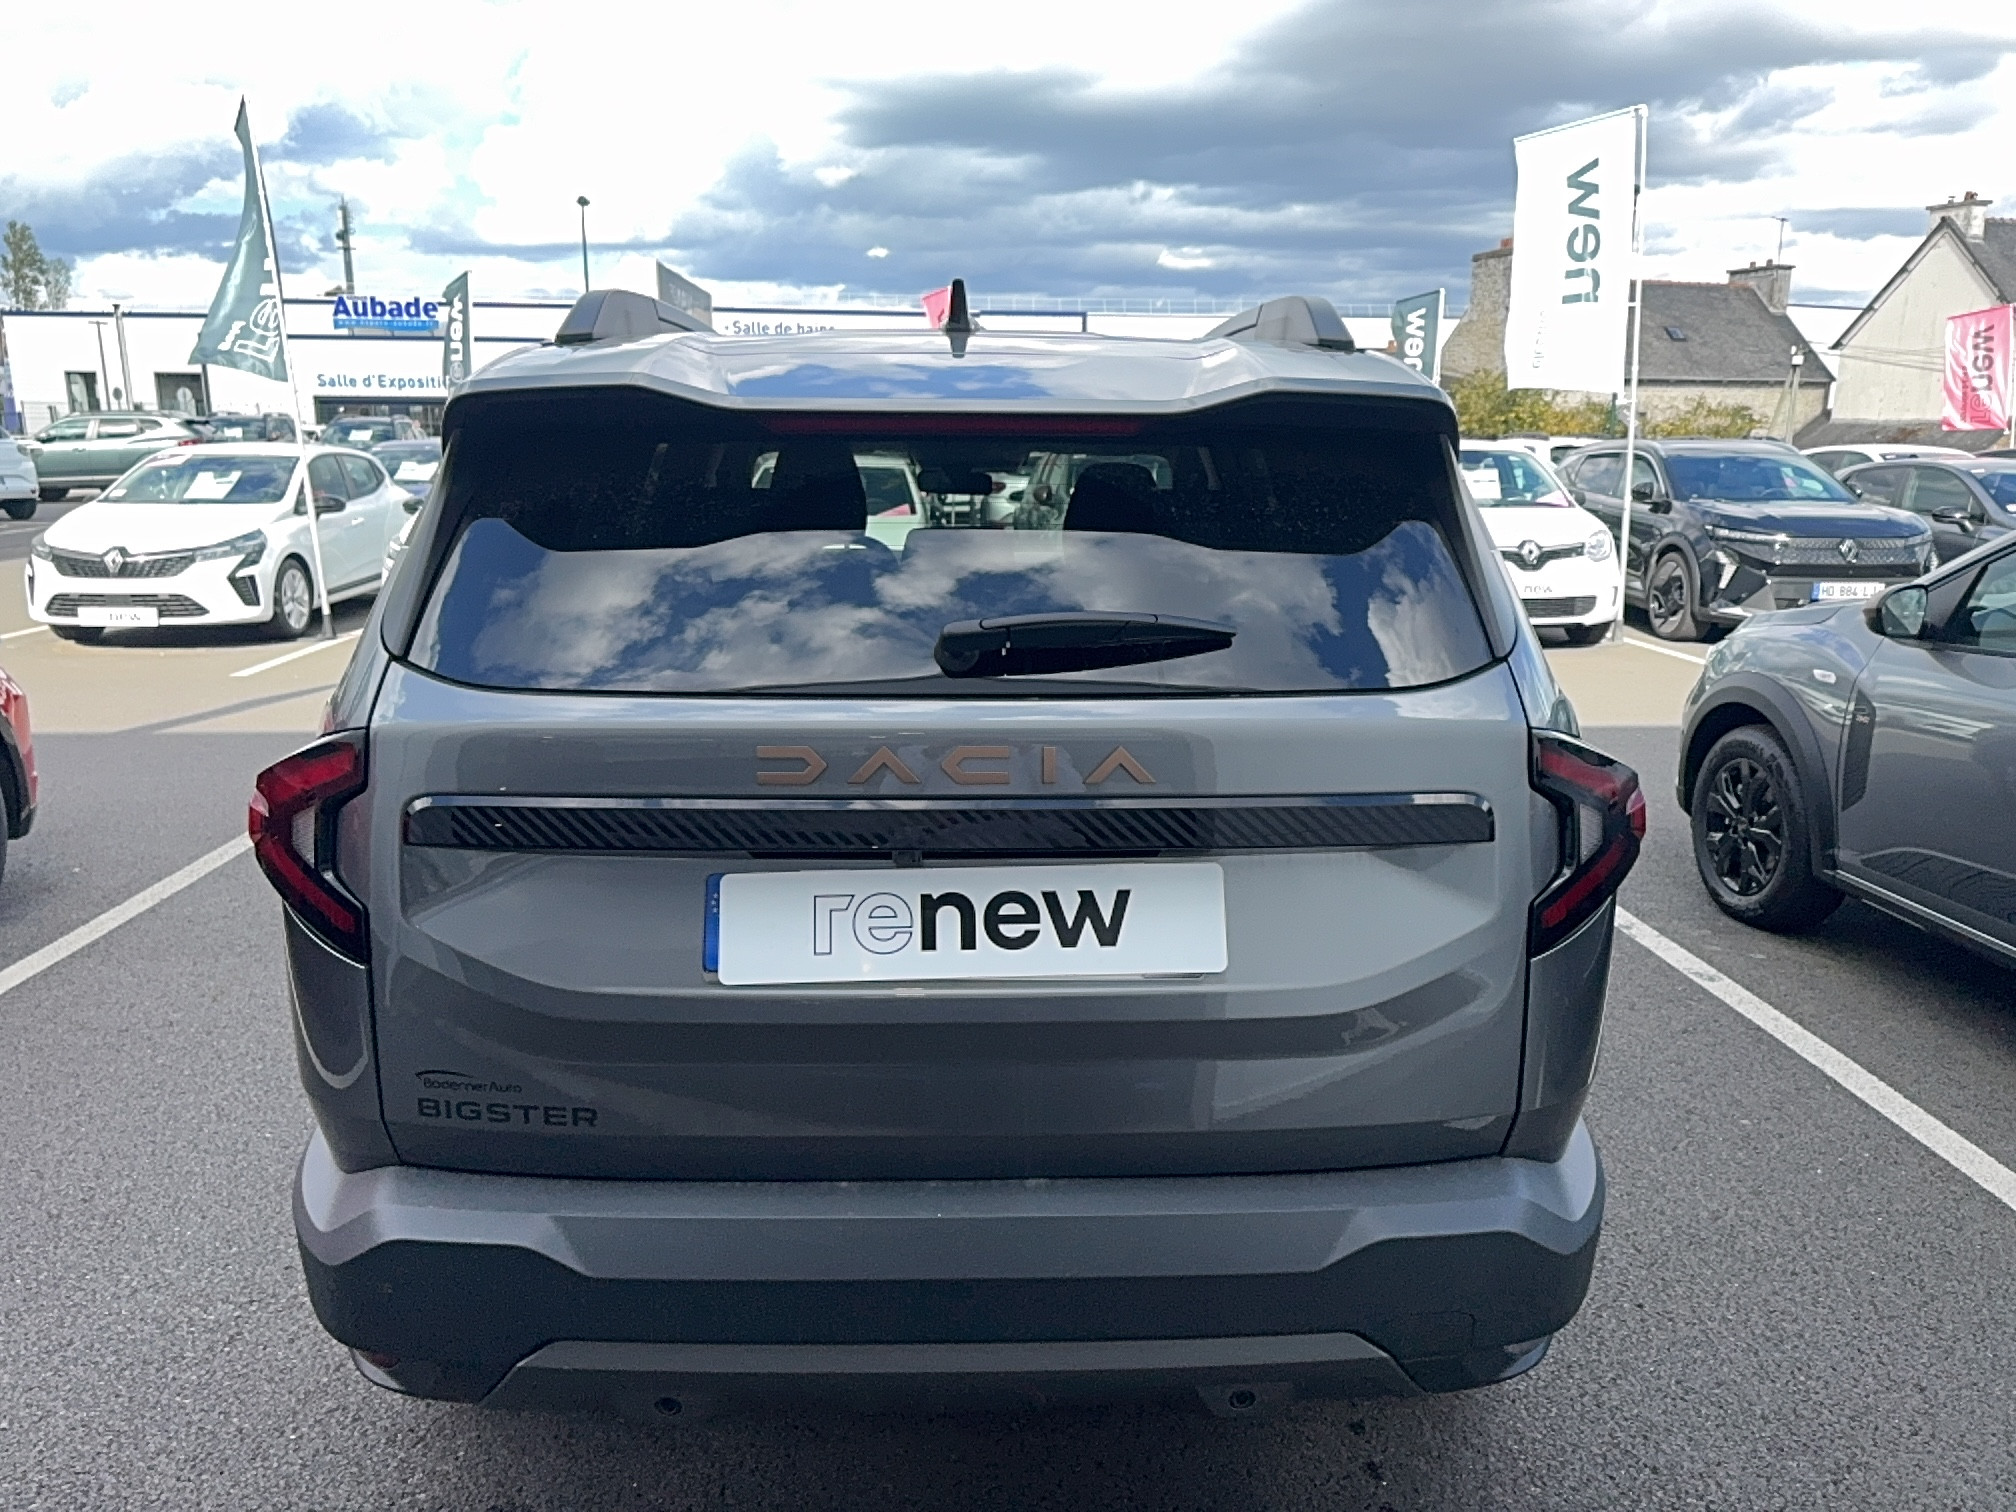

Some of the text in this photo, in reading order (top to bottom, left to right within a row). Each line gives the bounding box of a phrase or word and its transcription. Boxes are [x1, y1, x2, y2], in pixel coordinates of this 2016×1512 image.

[332, 296, 439, 318] Aubade
[732, 320, 770, 336] Salle
[775, 322, 793, 336] de
[316, 373, 358, 388] Salle
[756, 745, 1158, 785] DACIA
[813, 888, 1132, 956] renew
[417, 1097, 599, 1128] BIGSTER
